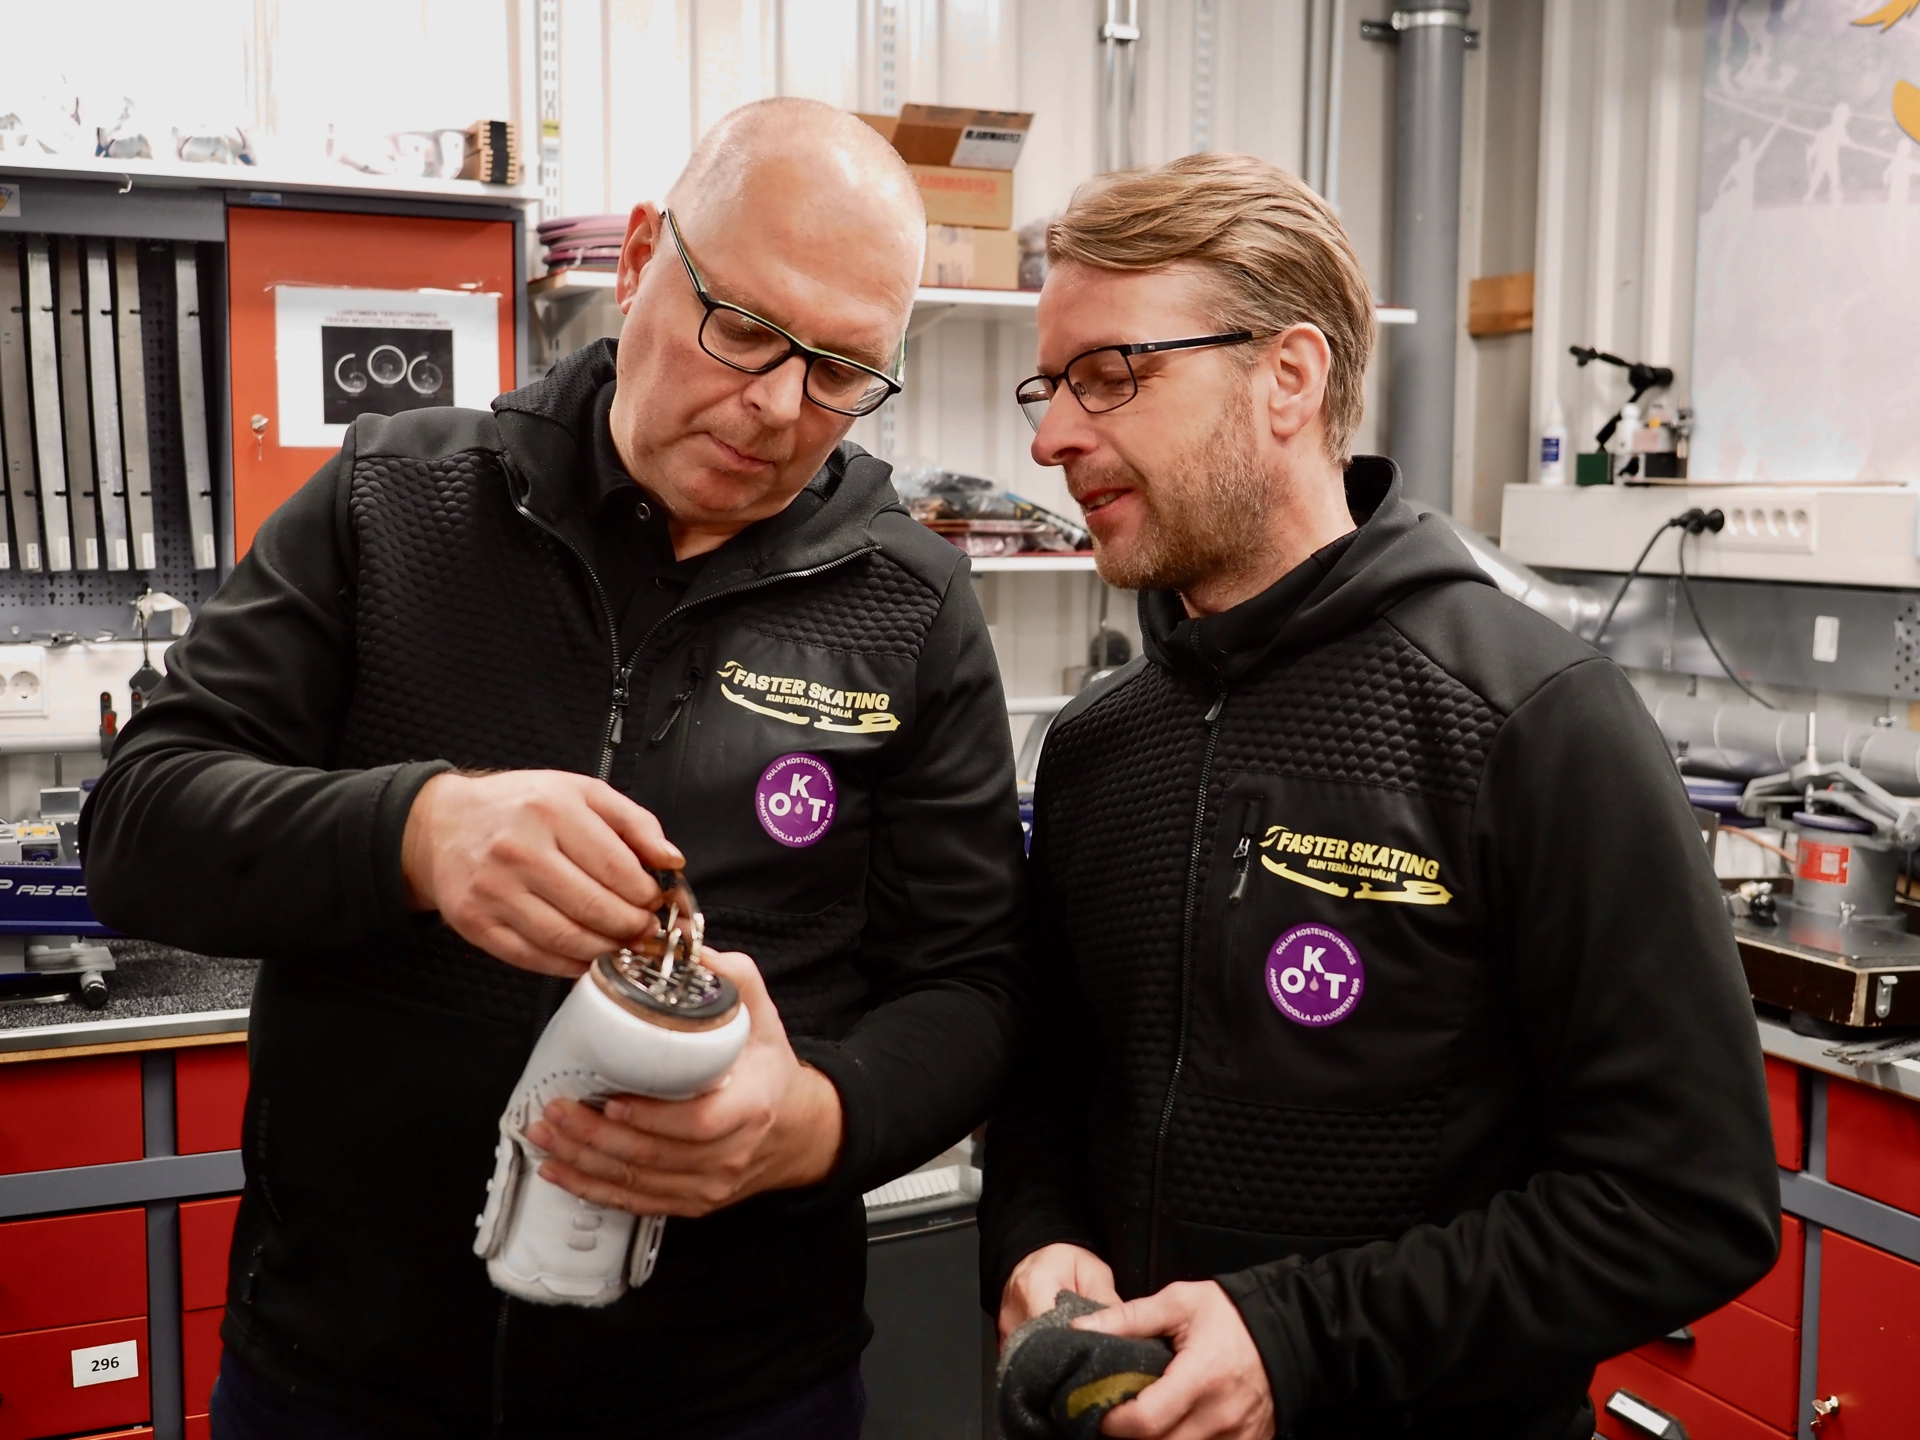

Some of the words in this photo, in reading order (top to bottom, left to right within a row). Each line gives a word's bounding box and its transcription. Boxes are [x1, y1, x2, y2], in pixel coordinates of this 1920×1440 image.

[733, 668, 806, 695] FASTER
[808, 682, 889, 710] SKATING
[766, 693, 784, 703] KUN
[784, 695, 818, 709] TERÄLLÄ
[819, 703, 829, 712] ON
[766, 761, 786, 781] OULUN
[786, 757, 834, 792] KOSTEUSTUTKIMUS
[802, 819, 829, 842] VUODESTA
[1276, 831, 1349, 860] FASTER
[1349, 842, 1440, 880] SKATING
[1307, 858, 1327, 870] KUN
[1358, 868, 1370, 878] ON
[1276, 933, 1296, 955] OULUN
[1296, 927, 1357, 965] KOSTEUSTUTKIMUS
[1322, 995, 1355, 1021] VUODESTA
[91, 1356, 120, 1372] 296
